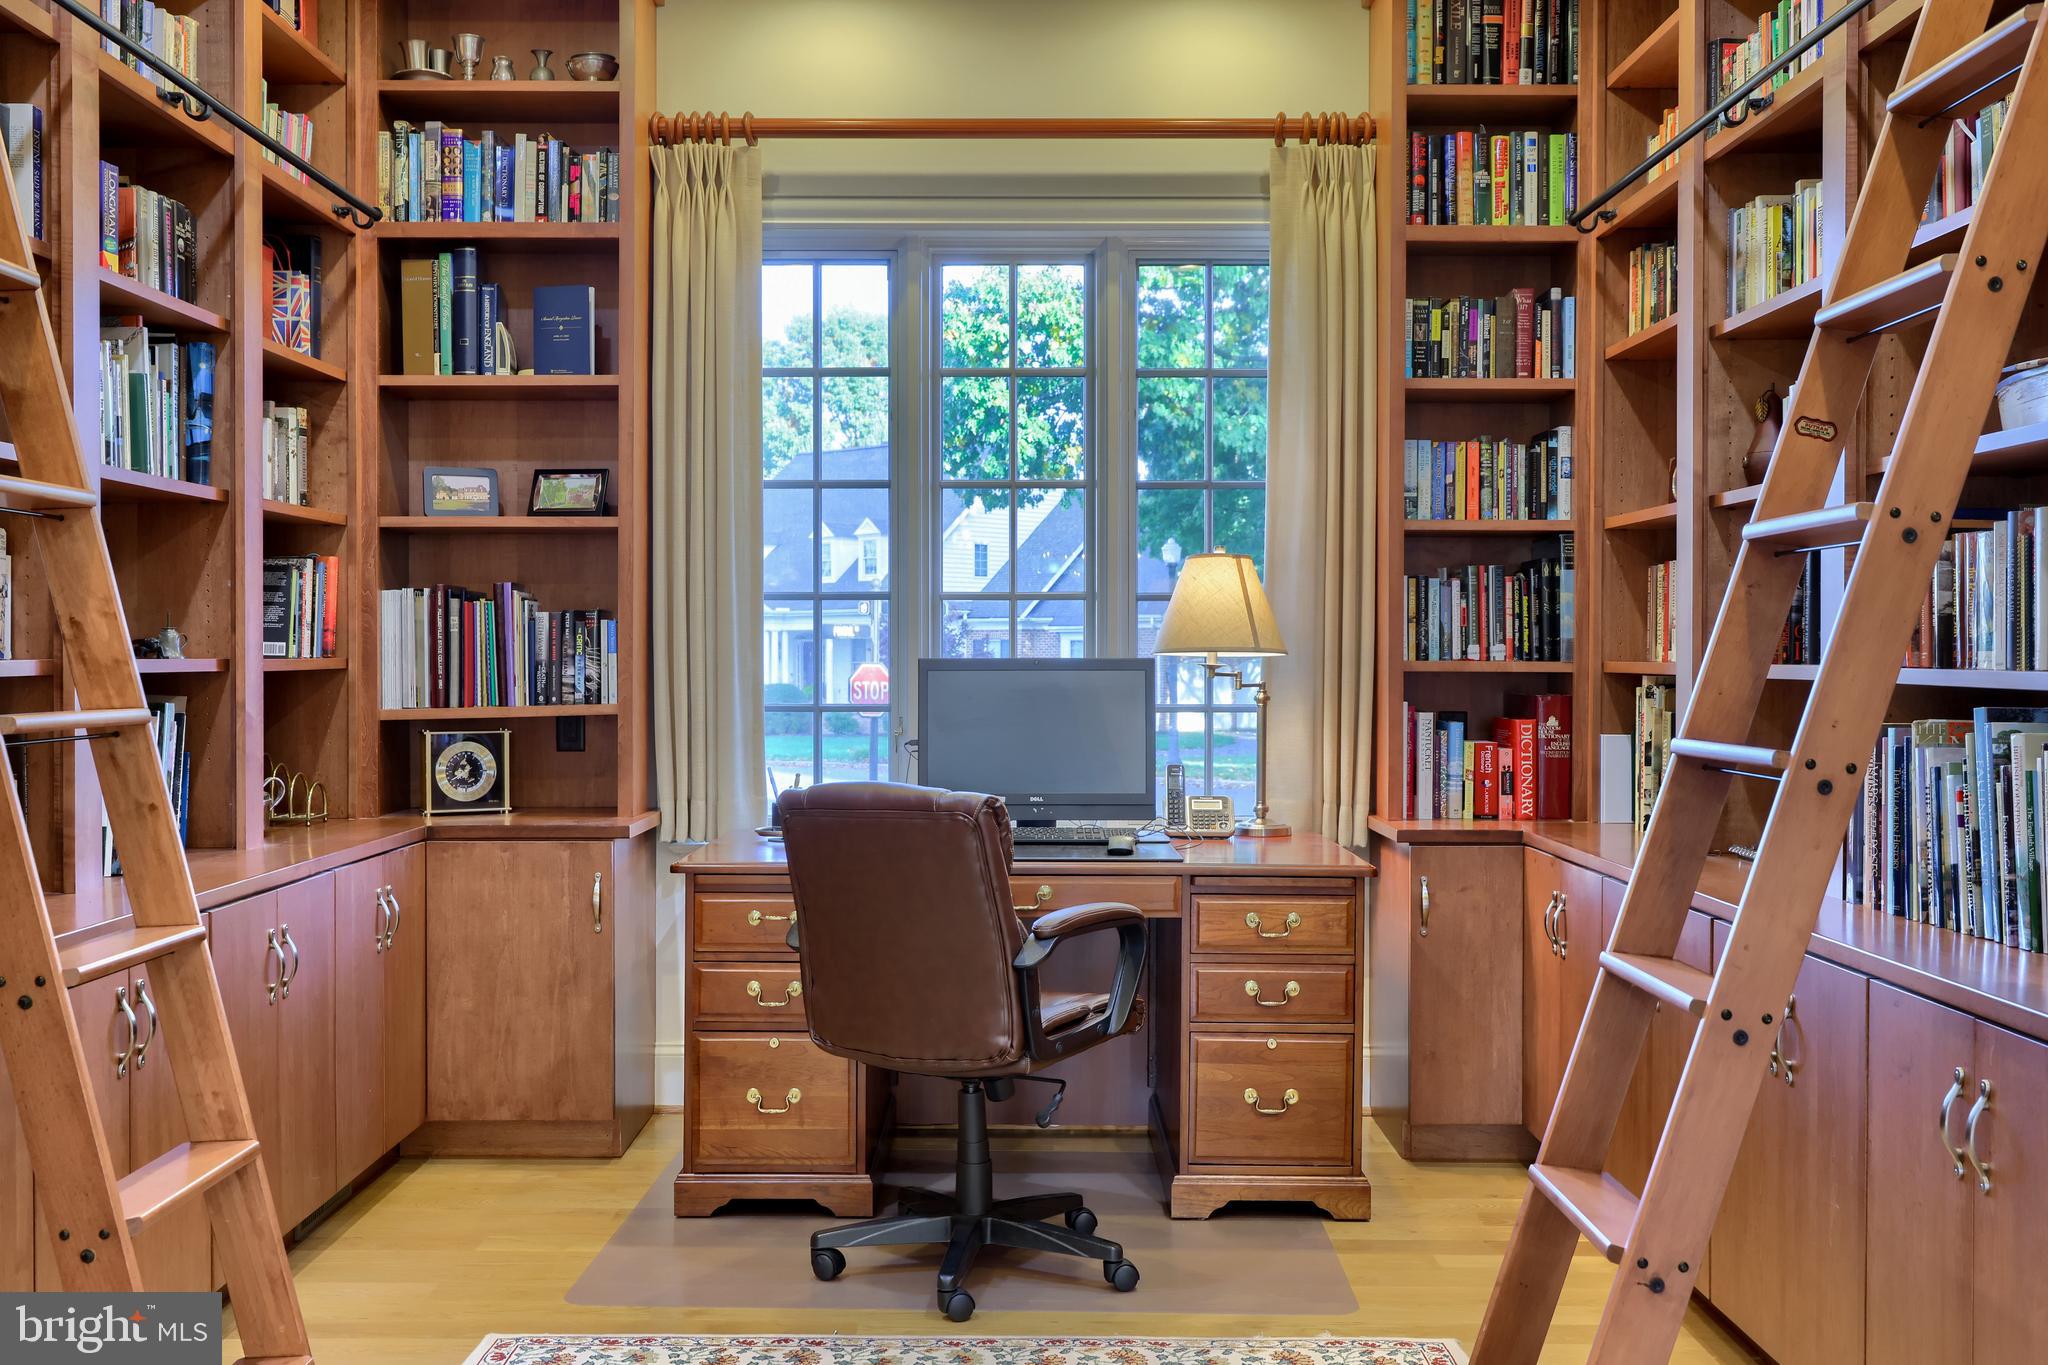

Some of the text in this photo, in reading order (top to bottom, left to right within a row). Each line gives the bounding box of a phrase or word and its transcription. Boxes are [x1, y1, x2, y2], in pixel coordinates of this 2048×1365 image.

[109, 170, 118, 239] LONGMAN
[483, 328, 492, 368] ENGLAND
[853, 681, 889, 700] STOP
[1485, 745, 1494, 774] French
[1520, 723, 1533, 817] DICTIONARY
[1893, 767, 1901, 785] THE
[1893, 786, 1901, 818] VILLAGE
[1976, 759, 1989, 887] FALLINGWATER
[2027, 820, 2035, 847] English
[1893, 834, 1901, 871] HISTORY
[1962, 783, 1973, 911] PREHISTORIC AVEBURY
